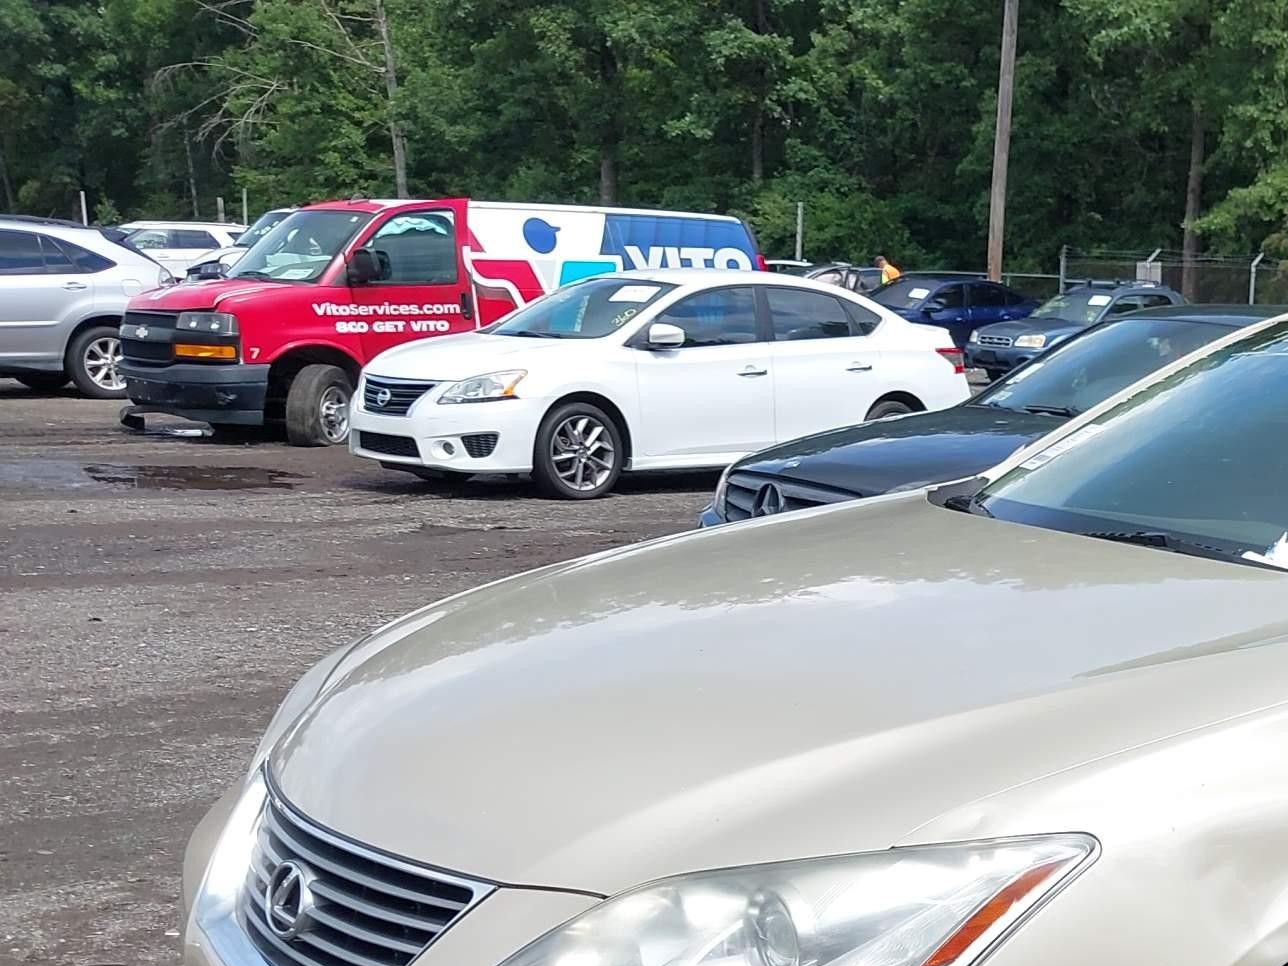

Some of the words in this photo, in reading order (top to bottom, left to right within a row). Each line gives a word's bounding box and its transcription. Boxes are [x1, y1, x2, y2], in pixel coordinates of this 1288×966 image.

[624, 246, 753, 271] VITO
[312, 301, 461, 316] VitoServices.com
[373, 320, 406, 333] GET
[410, 320, 450, 332] VITO
[249, 347, 260, 360] 7
